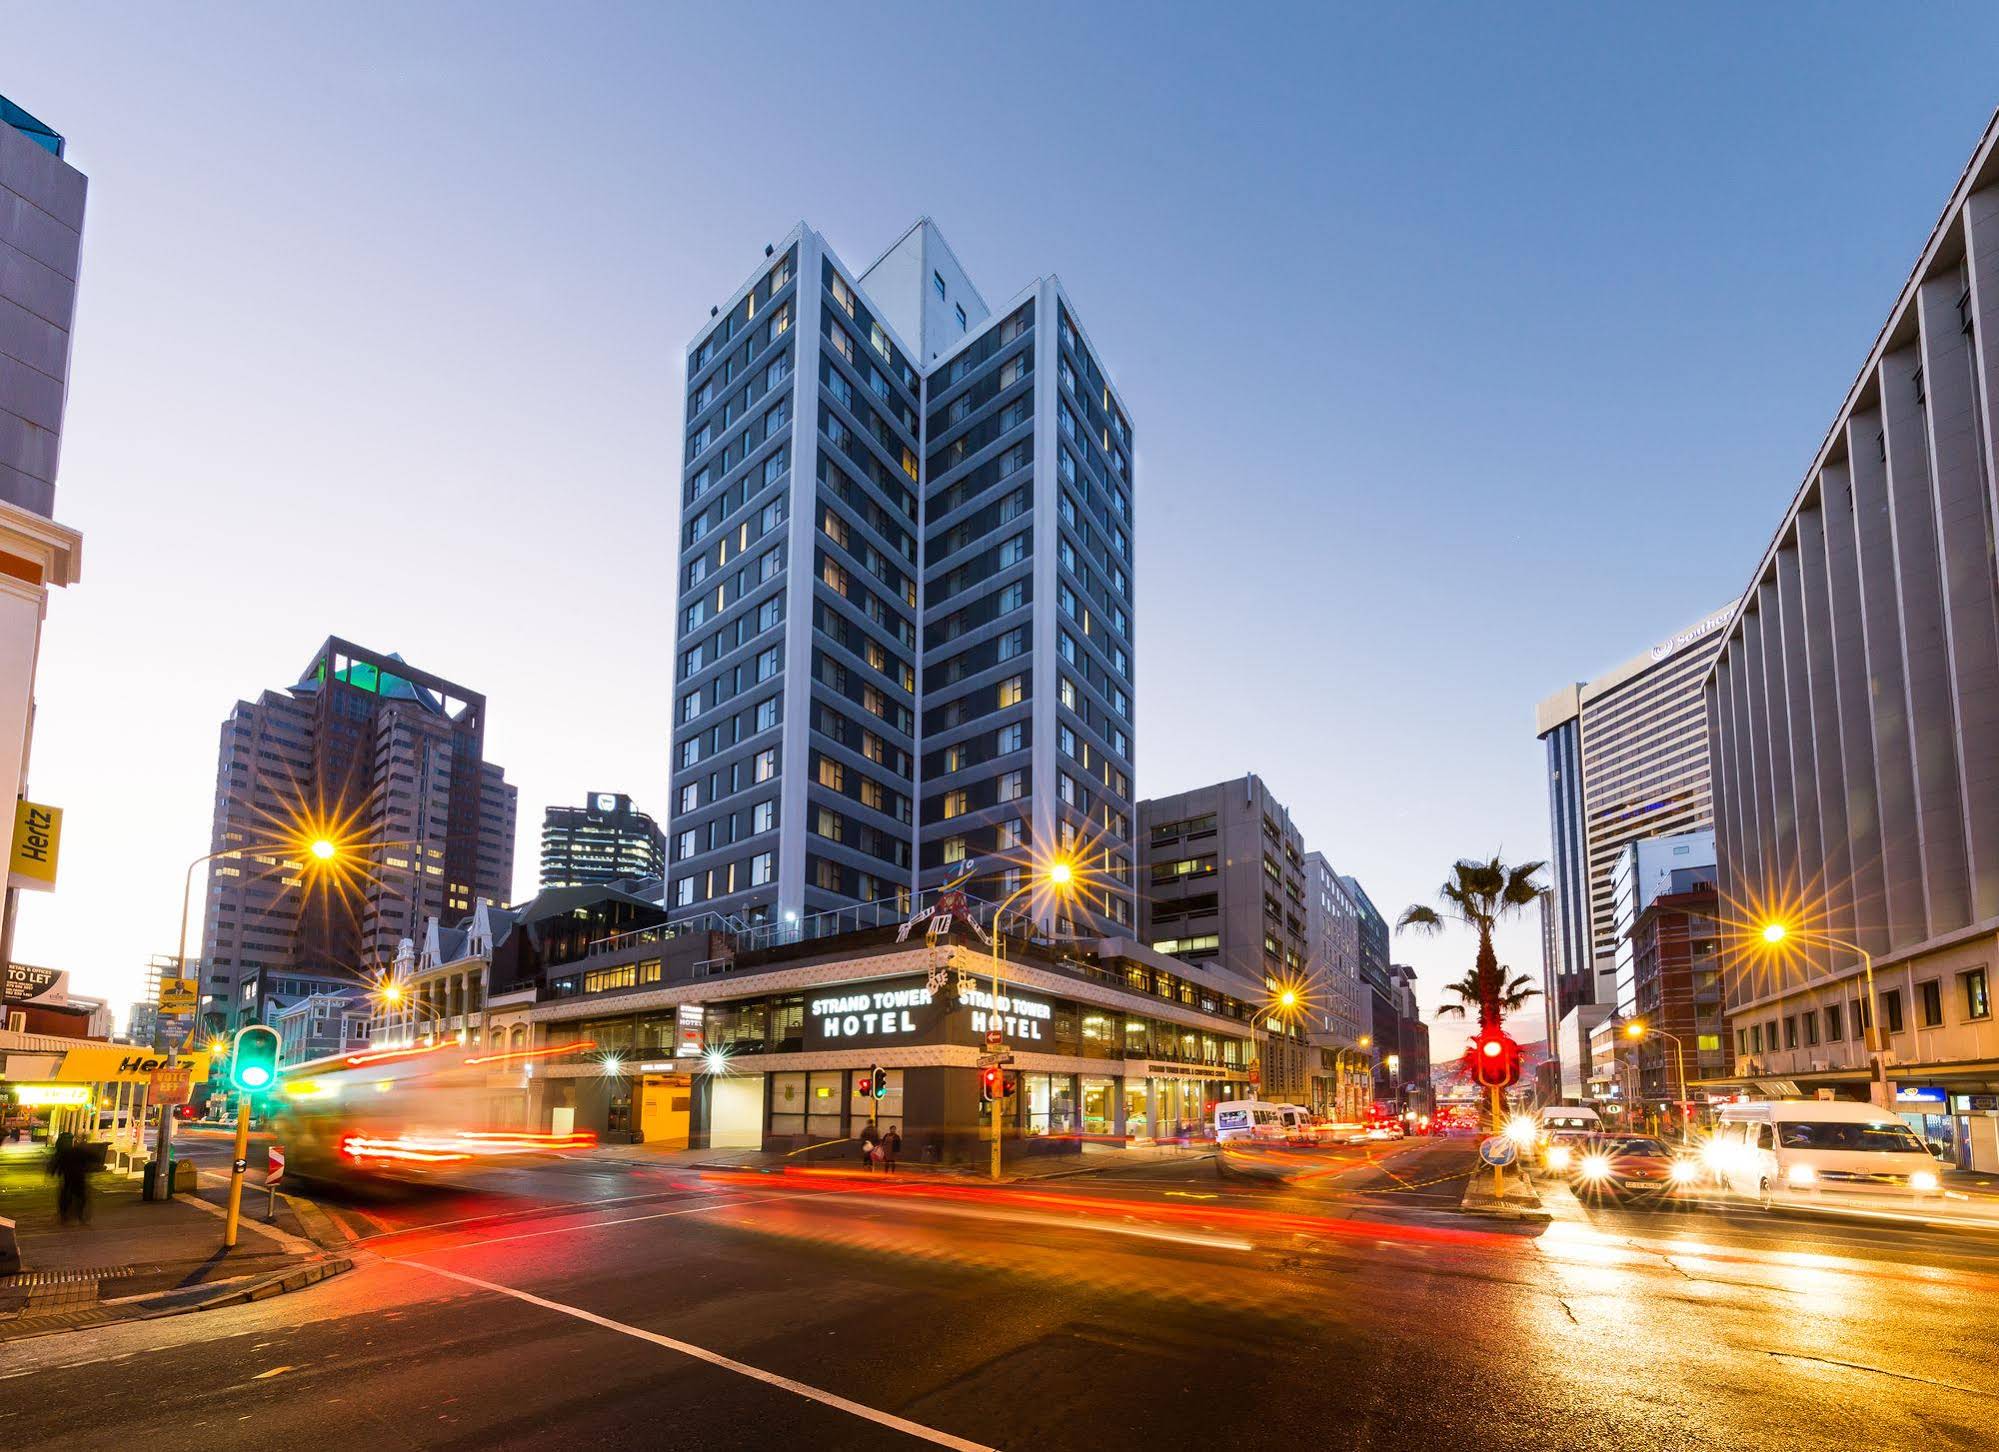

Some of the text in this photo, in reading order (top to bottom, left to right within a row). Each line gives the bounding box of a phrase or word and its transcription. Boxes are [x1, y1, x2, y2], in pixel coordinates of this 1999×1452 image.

[21, 808, 51, 862] Hertz
[8, 970, 51, 985] TO LET
[812, 988, 932, 1015] STRAND TOWER
[1012, 998, 1050, 1019] TOWER
[824, 1011, 916, 1037] HOTEL
[971, 1010, 1041, 1039] HOTEL
[157, 1073, 187, 1082] VOTE
